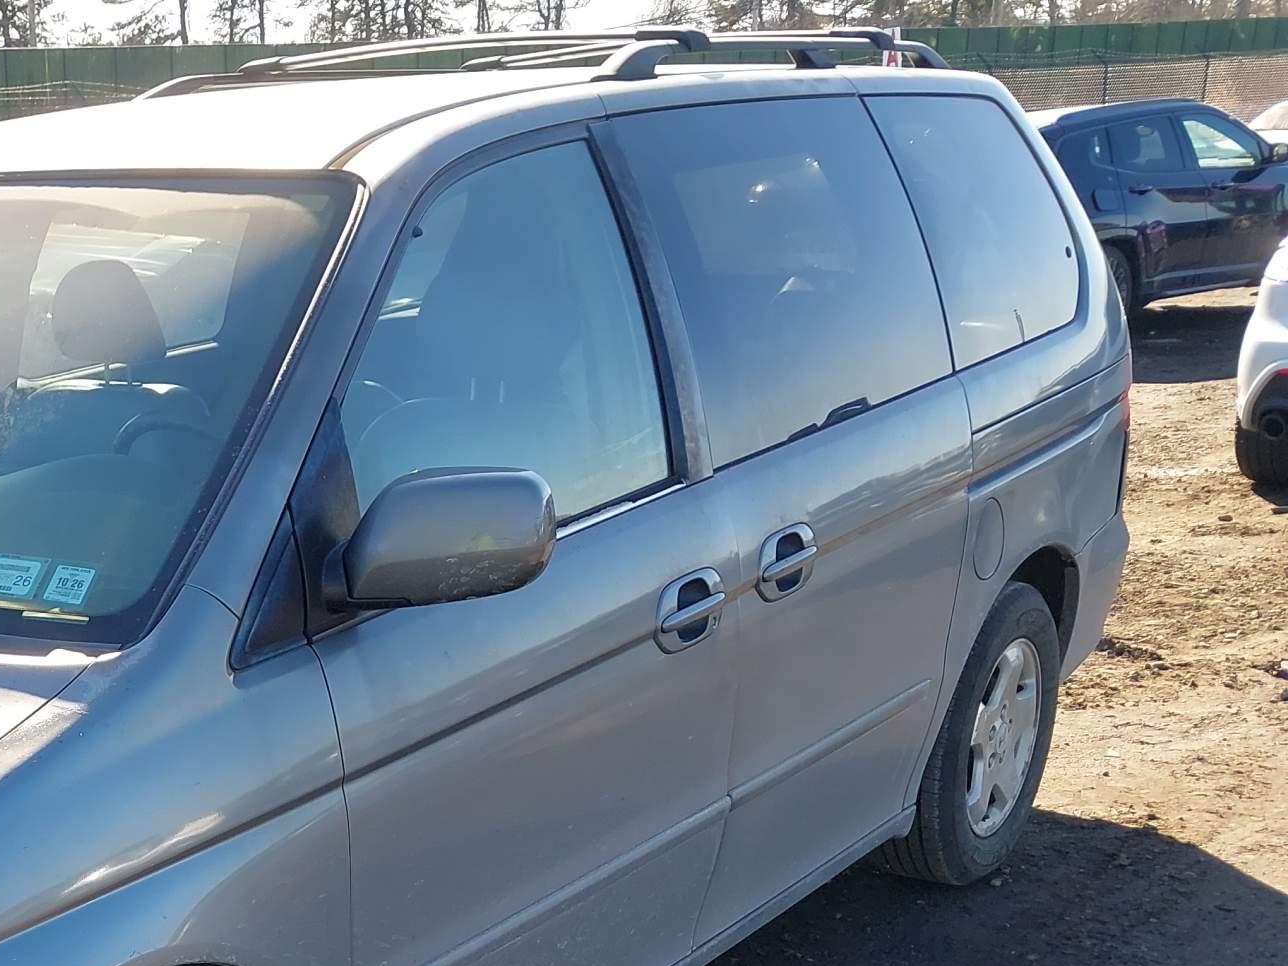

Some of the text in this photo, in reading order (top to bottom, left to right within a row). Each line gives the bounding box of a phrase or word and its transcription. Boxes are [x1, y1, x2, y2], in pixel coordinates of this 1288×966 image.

[13, 575, 33, 587] 26
[56, 577, 69, 587] 10
[70, 578, 85, 589] 26
